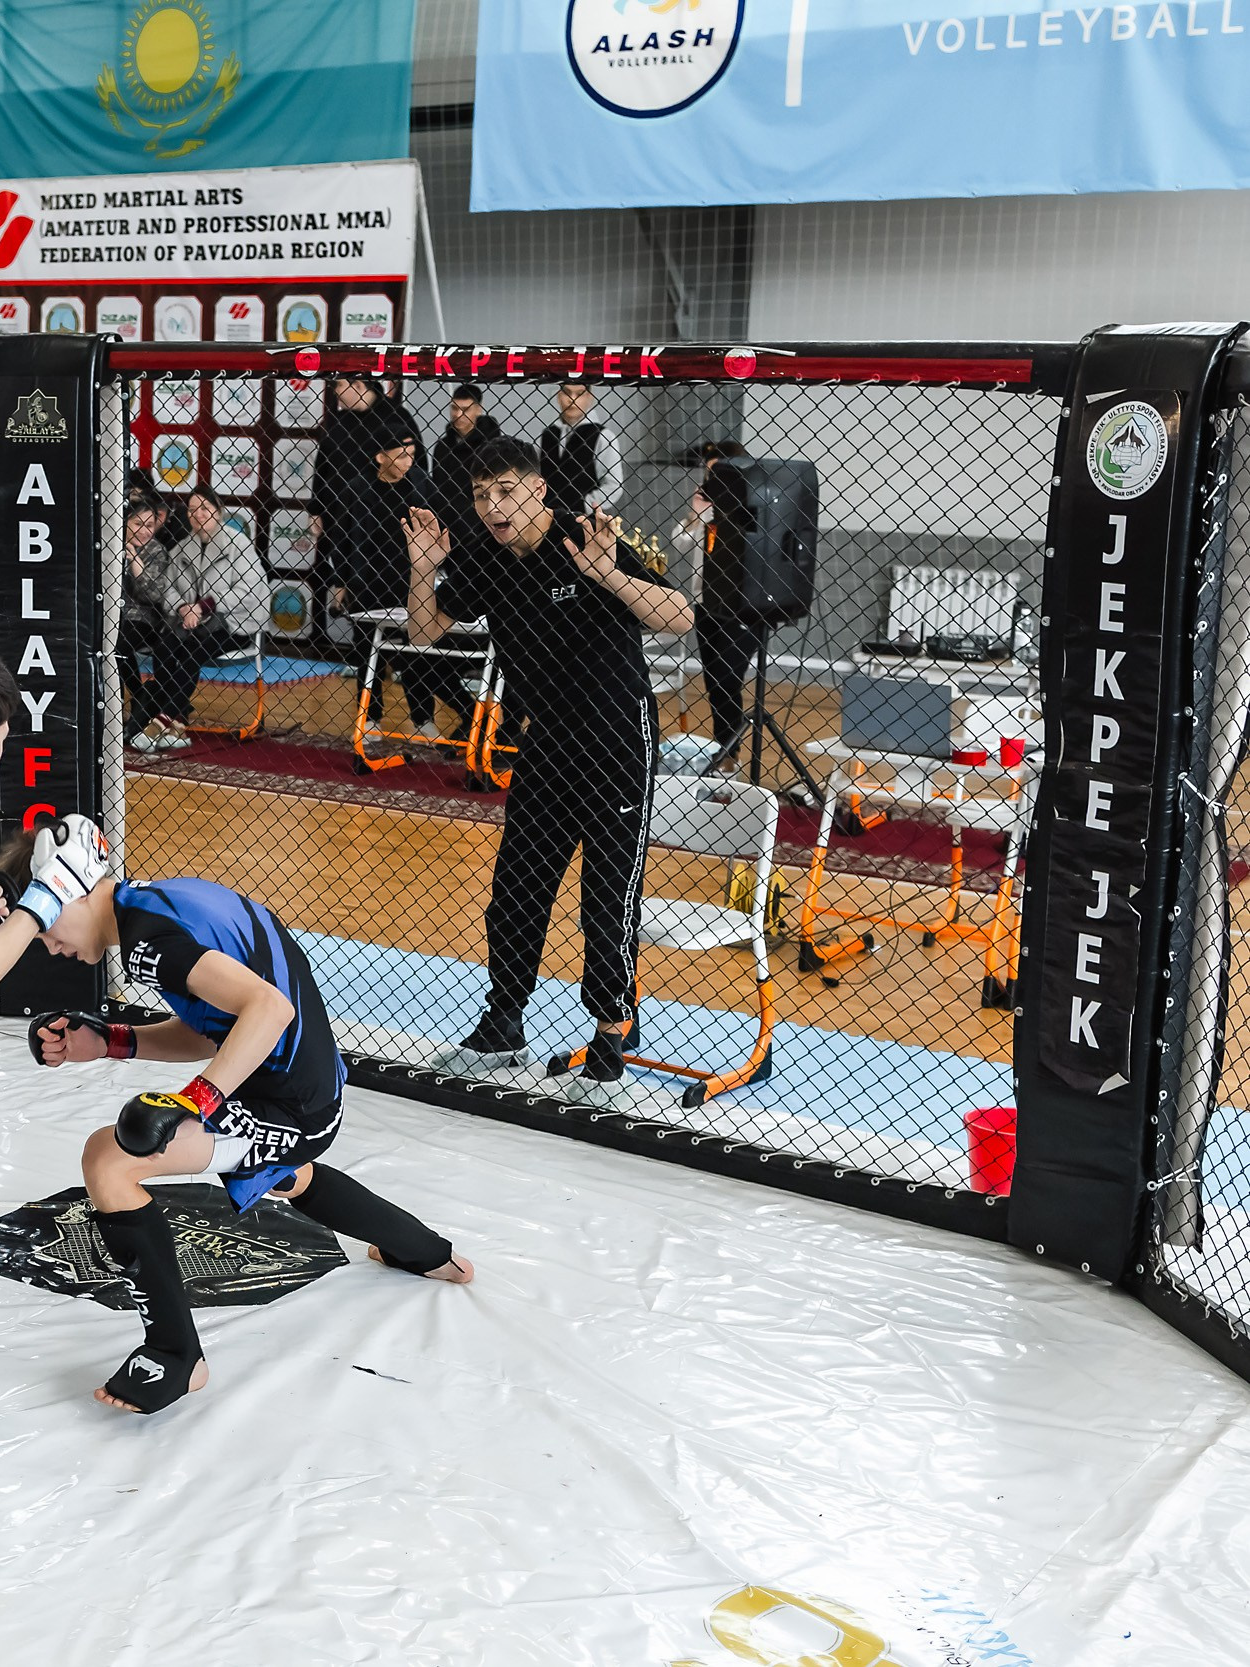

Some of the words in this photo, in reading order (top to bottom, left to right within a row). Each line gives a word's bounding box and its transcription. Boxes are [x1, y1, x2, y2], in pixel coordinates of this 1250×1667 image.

[591, 28, 715, 54] ALASH
[902, 0, 1245, 55] VOLLEYBALL
[608, 54, 694, 68] VOLLEYBALL
[40, 193, 97, 210] MIXED
[103, 190, 188, 208] MARTIAL
[194, 188, 243, 206] ARTS
[39, 218, 130, 238] (AMATEUR
[136, 218, 177, 235] AND
[183, 213, 330, 234] PROFESSIONAL
[336, 207, 391, 230] MMA)
[40, 245, 147, 263] FEDERATION
[154, 245, 177, 261] OF
[183, 243, 285, 261] PAVLODAR
[291, 241, 364, 259] REGION
[371, 345, 527, 377] JEKPE
[568, 346, 666, 378] JEK
[1136, 404, 1157, 421] SPORT
[1085, 514, 1127, 832] JEKPE
[128, 940, 149, 982] EEN
[1069, 870, 1110, 1050] JEK
